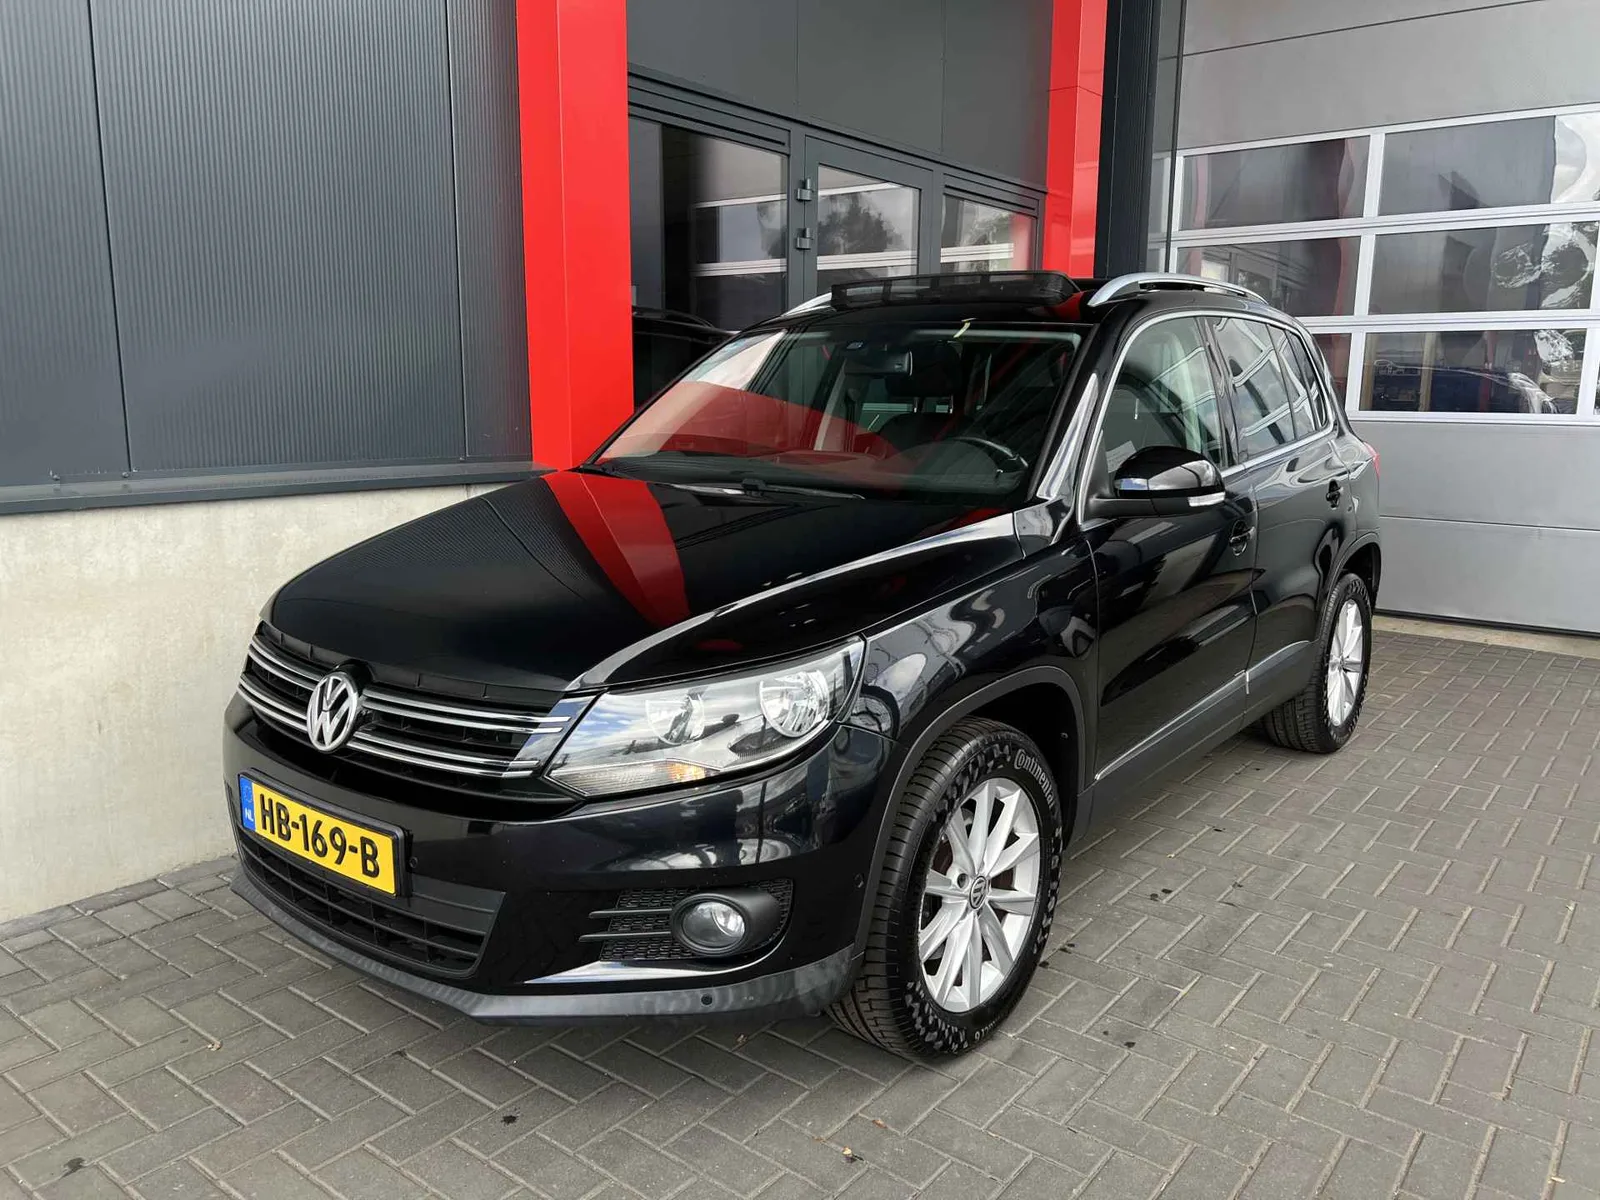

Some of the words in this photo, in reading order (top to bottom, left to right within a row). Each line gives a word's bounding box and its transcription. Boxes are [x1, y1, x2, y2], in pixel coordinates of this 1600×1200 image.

[307, 672, 359, 751] VW
[1014, 748, 1056, 810] Continental
[244, 807, 254, 822] NL
[259, 793, 380, 879] HB-169-B
